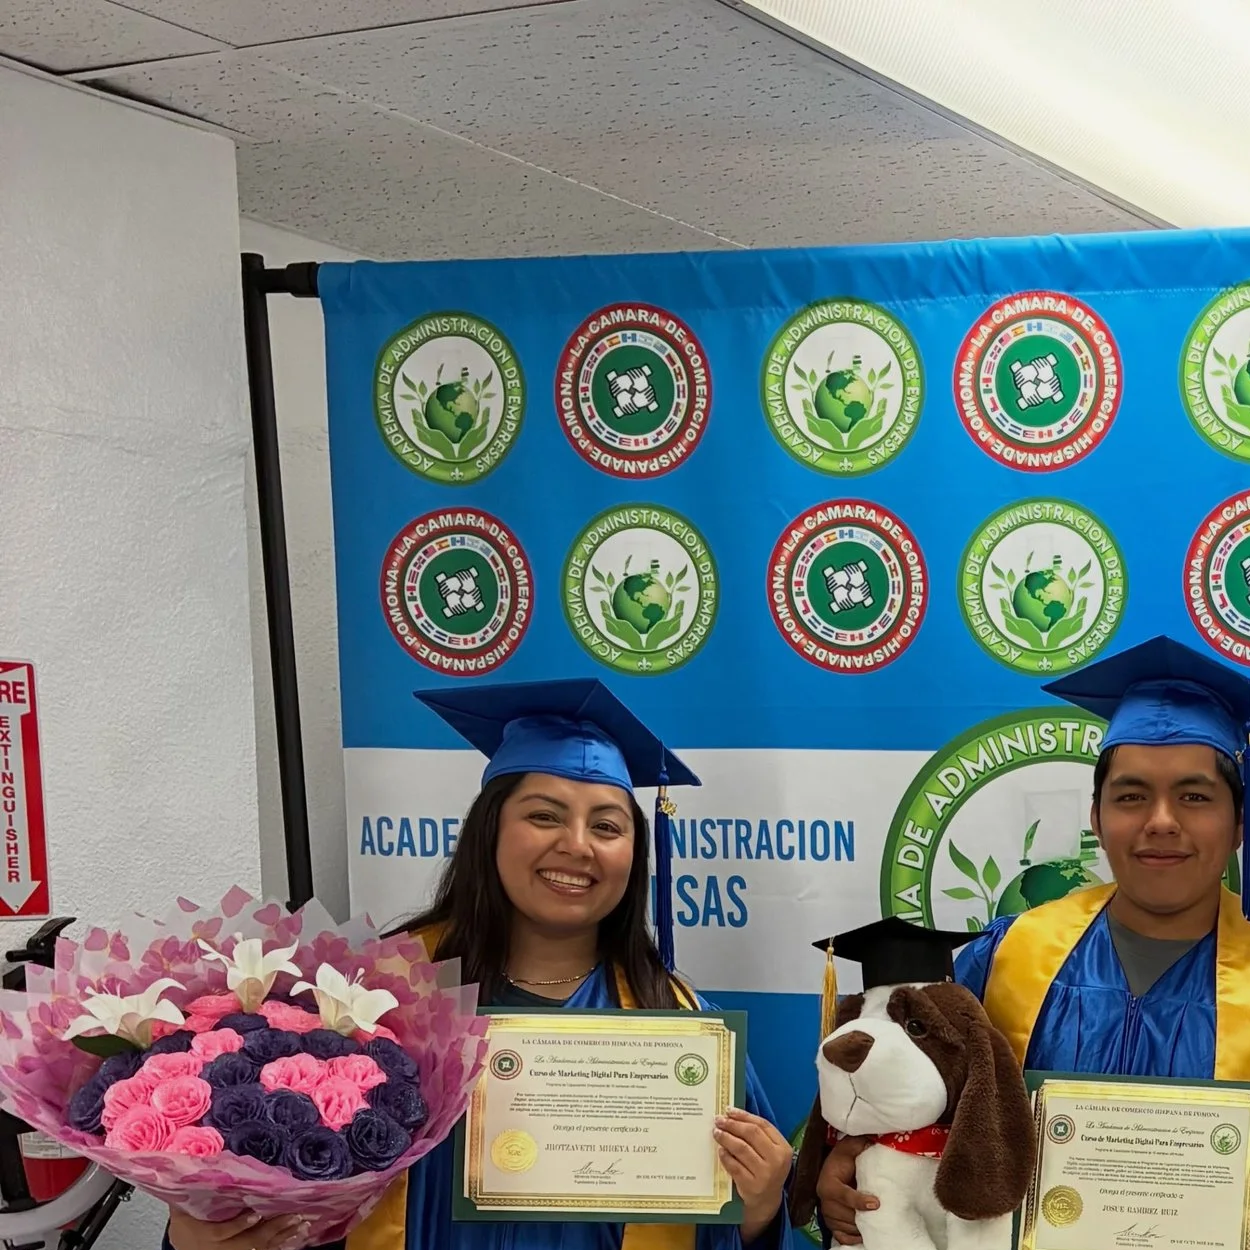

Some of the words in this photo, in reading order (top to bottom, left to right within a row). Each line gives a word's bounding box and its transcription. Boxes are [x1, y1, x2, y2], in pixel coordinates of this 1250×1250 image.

[392, 318, 510, 363] ADMINISTRACION
[784, 304, 910, 354] ADMINISTRACION
[1187, 340, 1205, 363] DE
[379, 362, 394, 384] DE
[505, 367, 520, 389] DE
[571, 336, 588, 357] LA
[589, 309, 659, 333] CAMARA
[665, 321, 685, 342] DE
[685, 343, 706, 441] COMERCIO
[768, 353, 786, 375] DE
[904, 357, 919, 379] DE
[971, 326, 992, 348] LA
[993, 297, 1066, 323] CAMARA
[1072, 308, 1094, 330] DE
[1092, 331, 1116, 432] COMERCIO
[380, 392, 433, 470] ACADEMIA
[476, 396, 520, 472] EMPRESAS
[768, 383, 822, 461] ACADEMIA
[868, 387, 919, 464] EMPRESAS
[1188, 371, 1242, 449] ACADEMIA
[582, 510, 705, 557] ADMINISTRACION
[981, 504, 1112, 552] ADMINISTRACION
[1201, 522, 1222, 544] LA
[396, 537, 415, 557] LA
[416, 514, 484, 536] CAMARA
[489, 524, 508, 545] DE
[508, 546, 528, 639] COMERCIO
[569, 557, 585, 578] DE
[700, 561, 714, 583] DE
[783, 531, 804, 551] LA
[804, 505, 875, 529] CAMARA
[881, 517, 902, 539] DE
[900, 540, 923, 637] COMERCIO
[966, 552, 983, 574] DE
[1105, 556, 1121, 579] DE
[569, 586, 621, 661] ACADEMIA
[667, 590, 714, 664] EMPRESAS
[966, 583, 1021, 661] ACADEMIA
[1068, 586, 1122, 663] EMPRESAS
[0, 681, 26, 704] RE
[897, 820, 933, 870] DE
[924, 722, 1104, 820] ADMINISTR
[360, 816, 459, 858] ACADE
